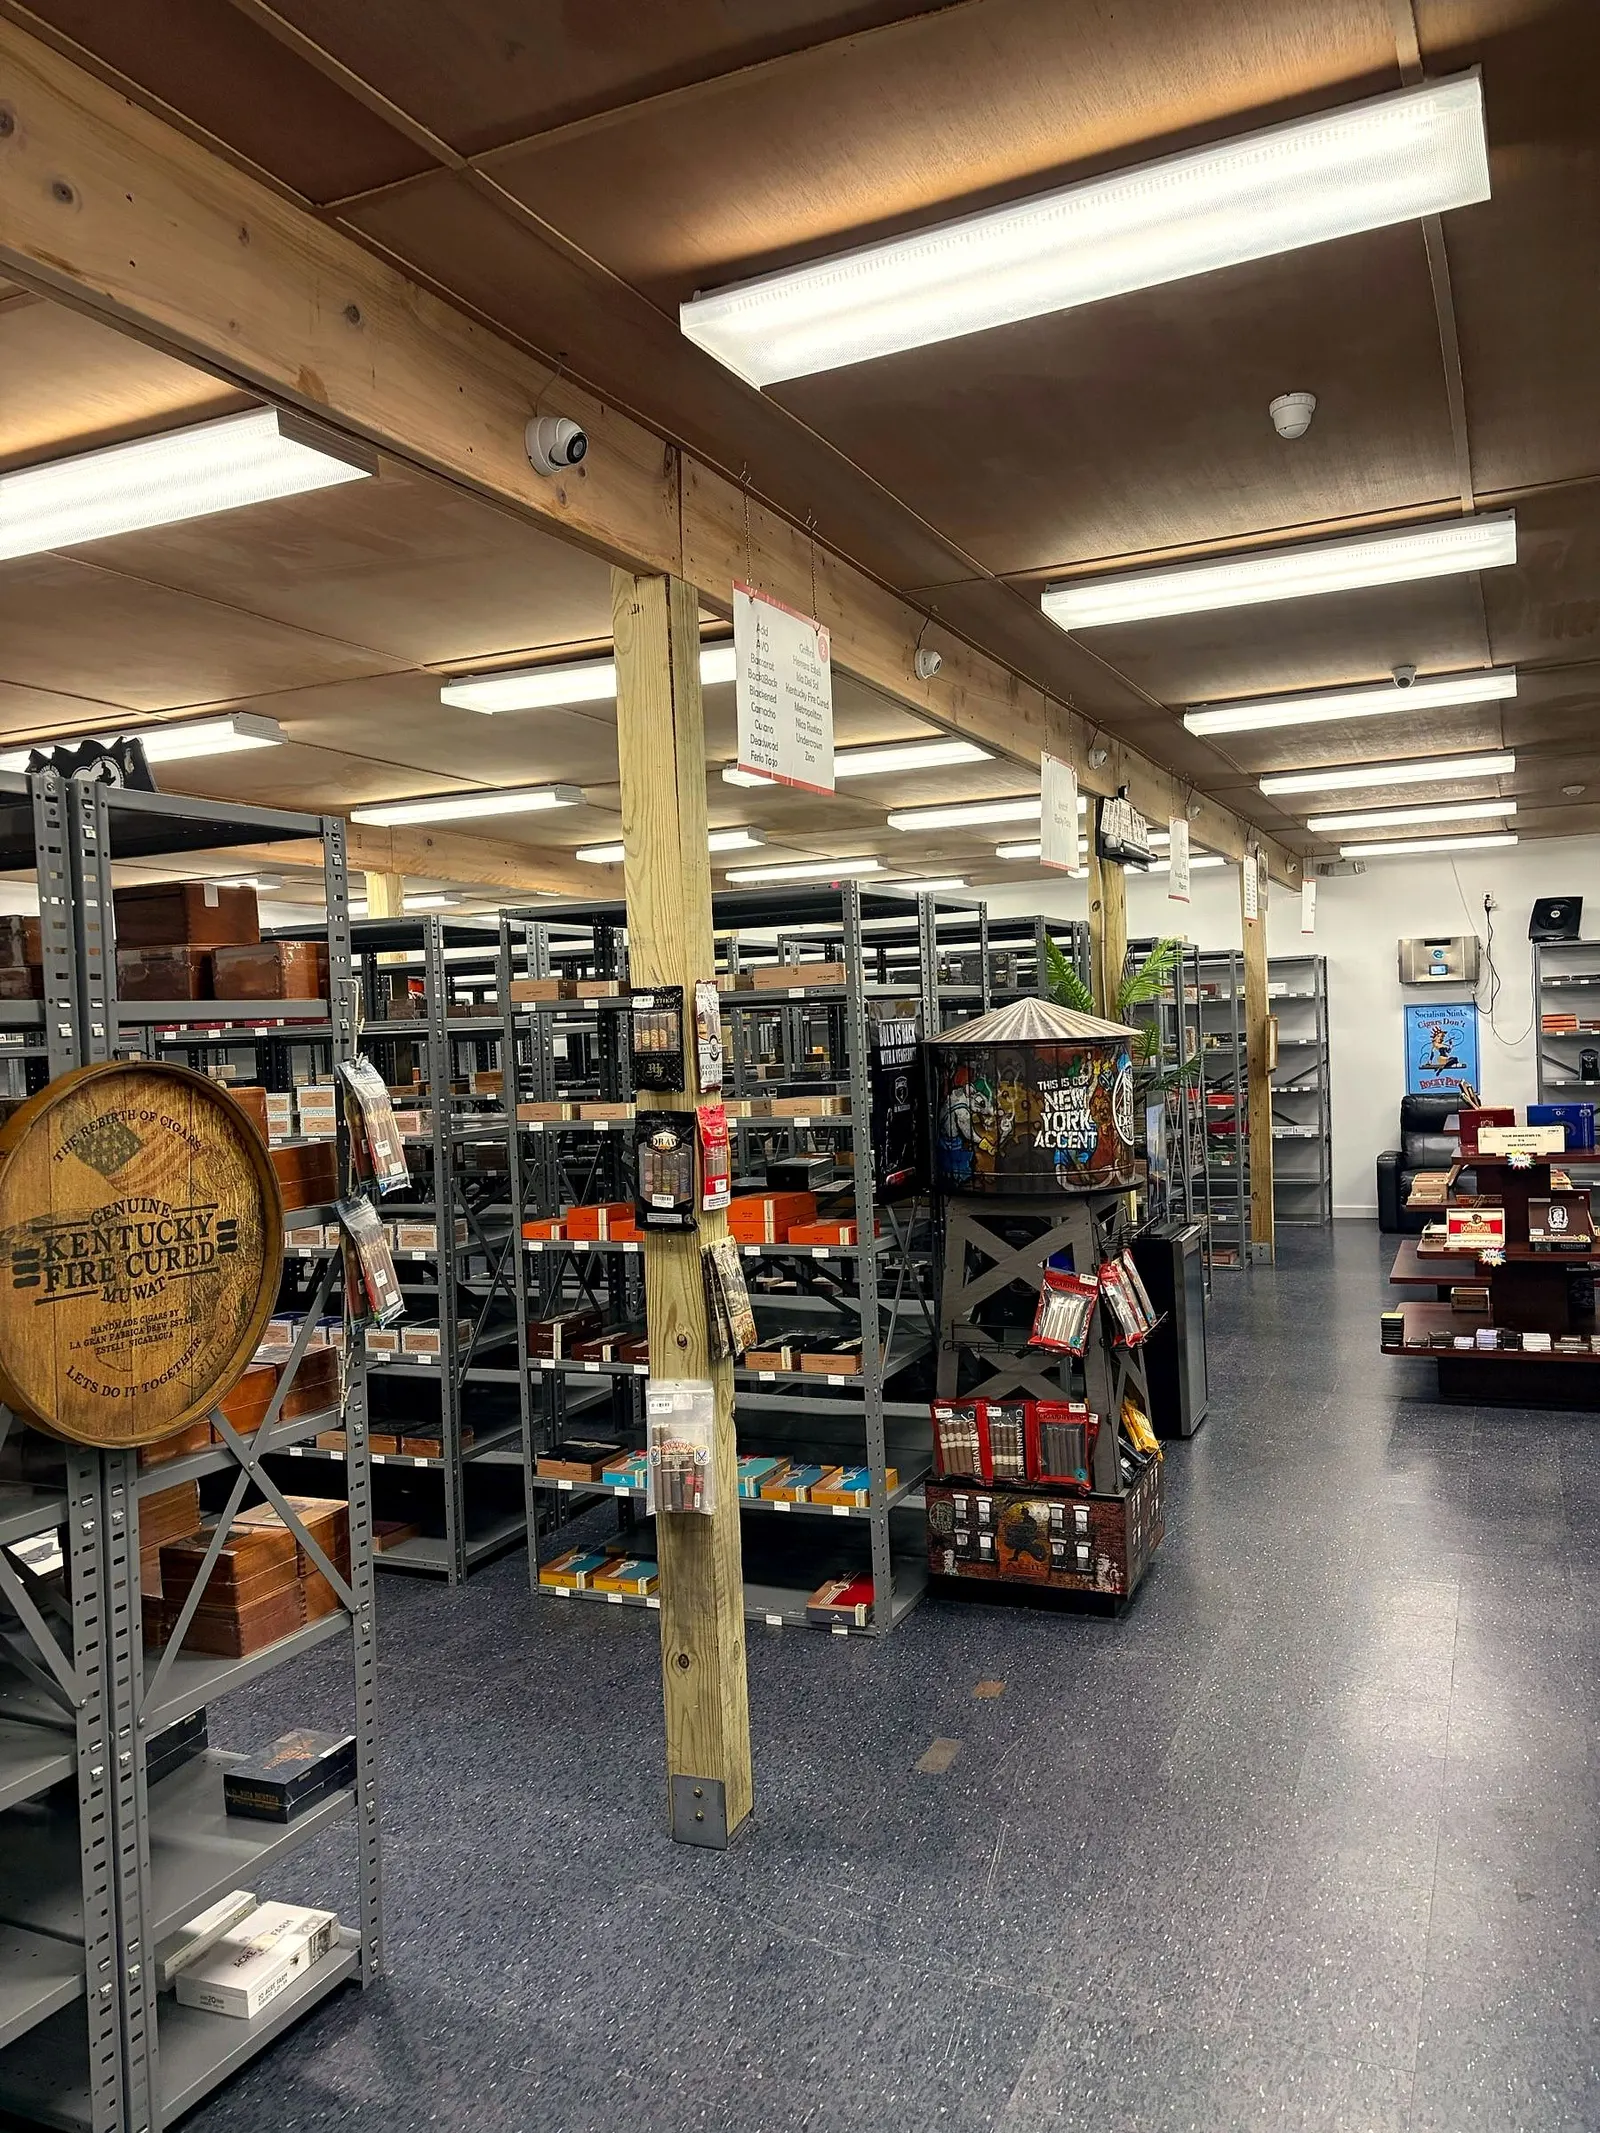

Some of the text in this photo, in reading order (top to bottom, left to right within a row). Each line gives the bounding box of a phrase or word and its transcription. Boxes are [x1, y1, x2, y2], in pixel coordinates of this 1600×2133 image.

[750, 733, 779, 751] Deadwood
[1414, 1009, 1467, 1019] Socialism Stinks
[1417, 1018, 1466, 1029] Cigars Don't
[1037, 1079, 1058, 1091] THIS
[1061, 1077, 1070, 1088] IS
[1043, 1087, 1088, 1112] NEW
[1040, 1109, 1092, 1132] YORK
[53, 1109, 202, 1164] THE REBIRTH OF CIGARS
[1033, 1130, 1098, 1149] ACCENT
[90, 1197, 172, 1227] GENUINE
[43, 1213, 213, 1263] KENTUCKY
[43, 1242, 215, 1293] FIRE CURED
[69, 1315, 199, 1351] LA GRAN FABRICA DREW ESTATE
[90, 1309, 180, 1335] HANDMADE CIGARS BY
[129, 1331, 174, 1348] NICARAGUA
[66, 1337, 202, 1398] LETS DO IT TOGETHER
[1016, 1409, 1025, 1477] CIGARNIVERSE
[233, 1919, 294, 1968] ACRE FARM
[277, 1972, 288, 1984] FARM
